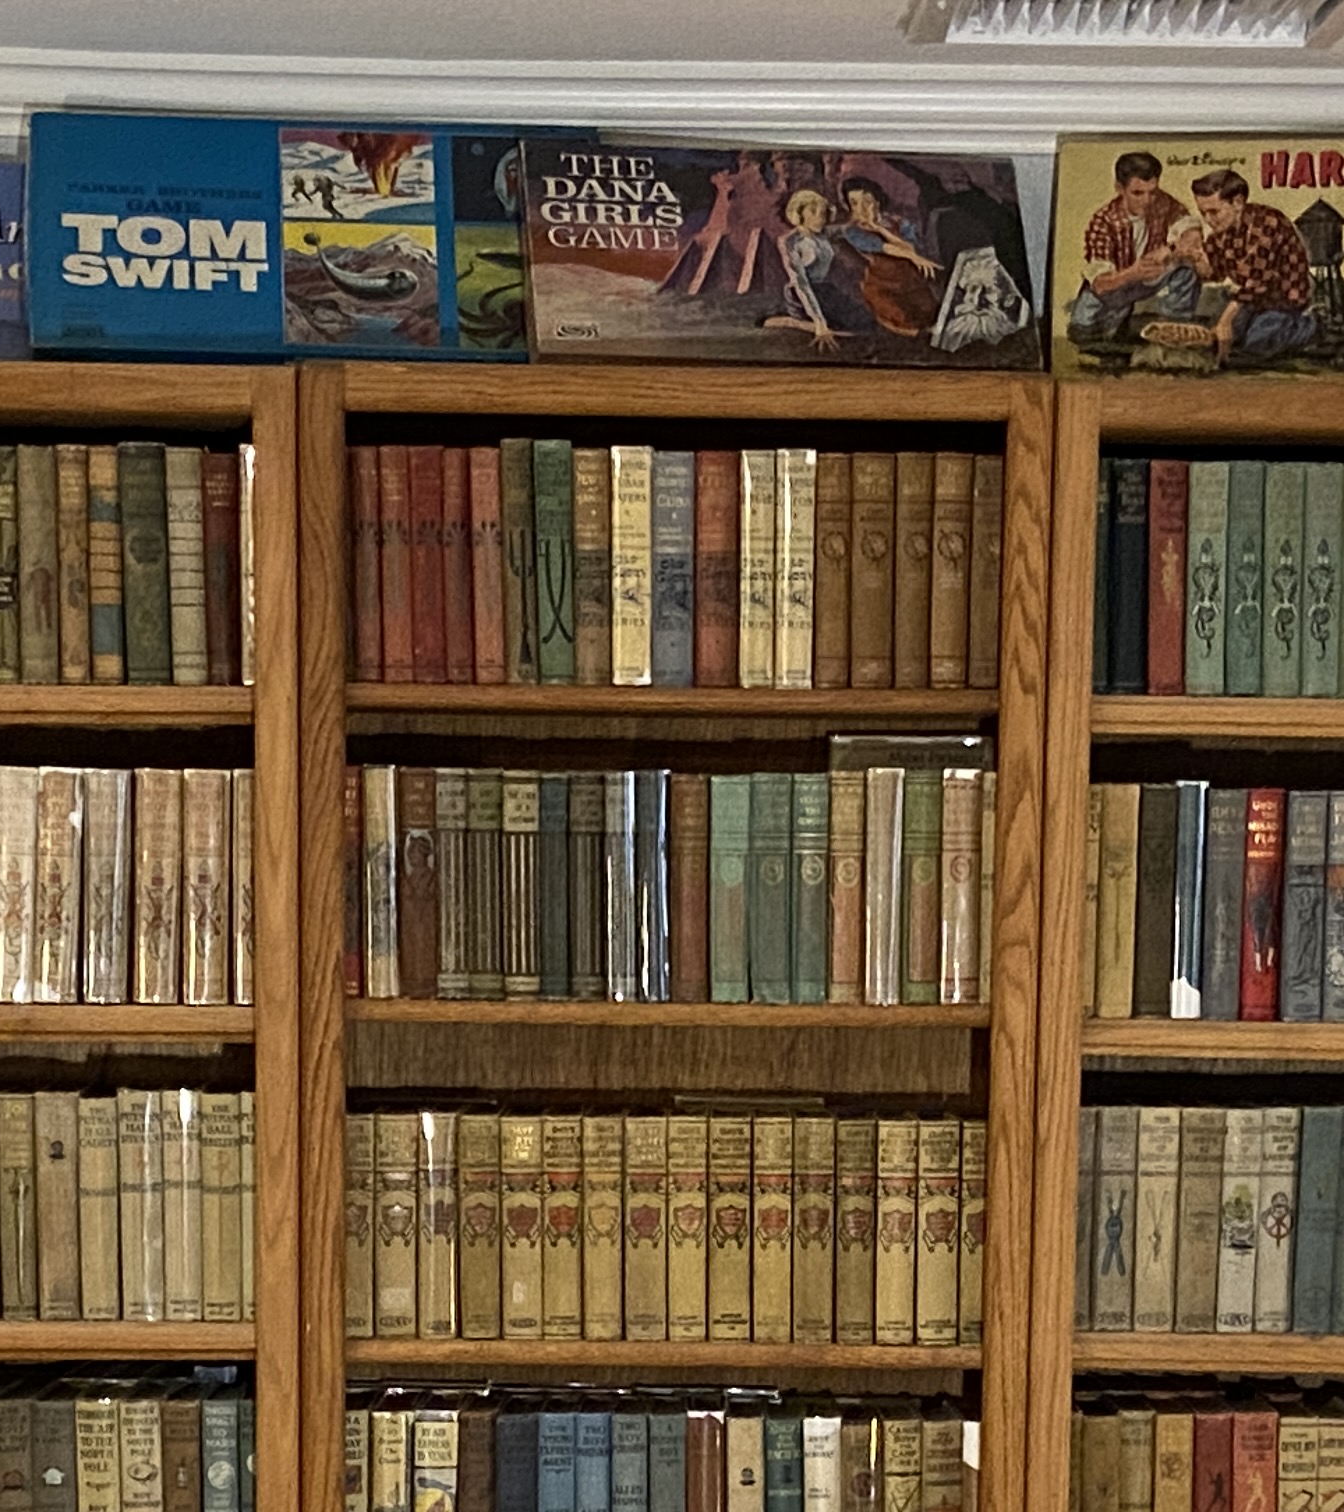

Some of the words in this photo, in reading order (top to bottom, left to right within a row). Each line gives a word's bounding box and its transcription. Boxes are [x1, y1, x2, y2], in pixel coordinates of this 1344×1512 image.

[560, 153, 656, 180] THE
[542, 176, 681, 204] DANA
[540, 201, 684, 228] GIRLS
[61, 213, 268, 261] TOM
[547, 225, 680, 251] GAME
[62, 253, 270, 293] SWIFT
